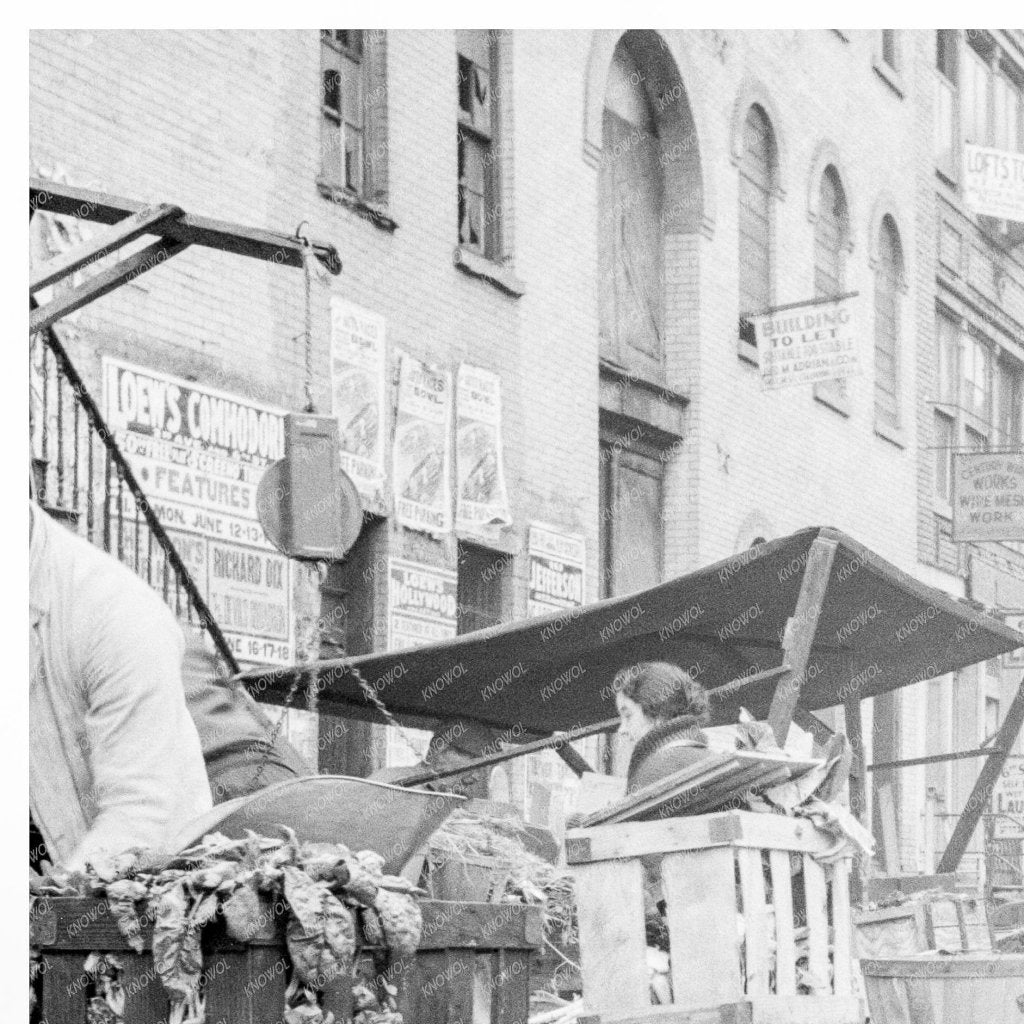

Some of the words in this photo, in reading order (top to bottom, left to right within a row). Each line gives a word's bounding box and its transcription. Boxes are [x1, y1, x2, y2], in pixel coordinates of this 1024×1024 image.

[967, 150, 1009, 180] LOFTS
[762, 308, 851, 337] BUILDING
[771, 335, 793, 348] TO
[801, 328, 838, 344] LET
[155, 465, 251, 510] FEATURES
[973, 474, 1018, 490] WORKS
[192, 512, 223, 534] JUNE
[970, 511, 1013, 524] WORK
[213, 547, 262, 586] RICHARD
[266, 558, 284, 590] DIX
[391, 577, 457, 617] HOLLYWOOD
[248, 639, 290, 660] 16-17-18
